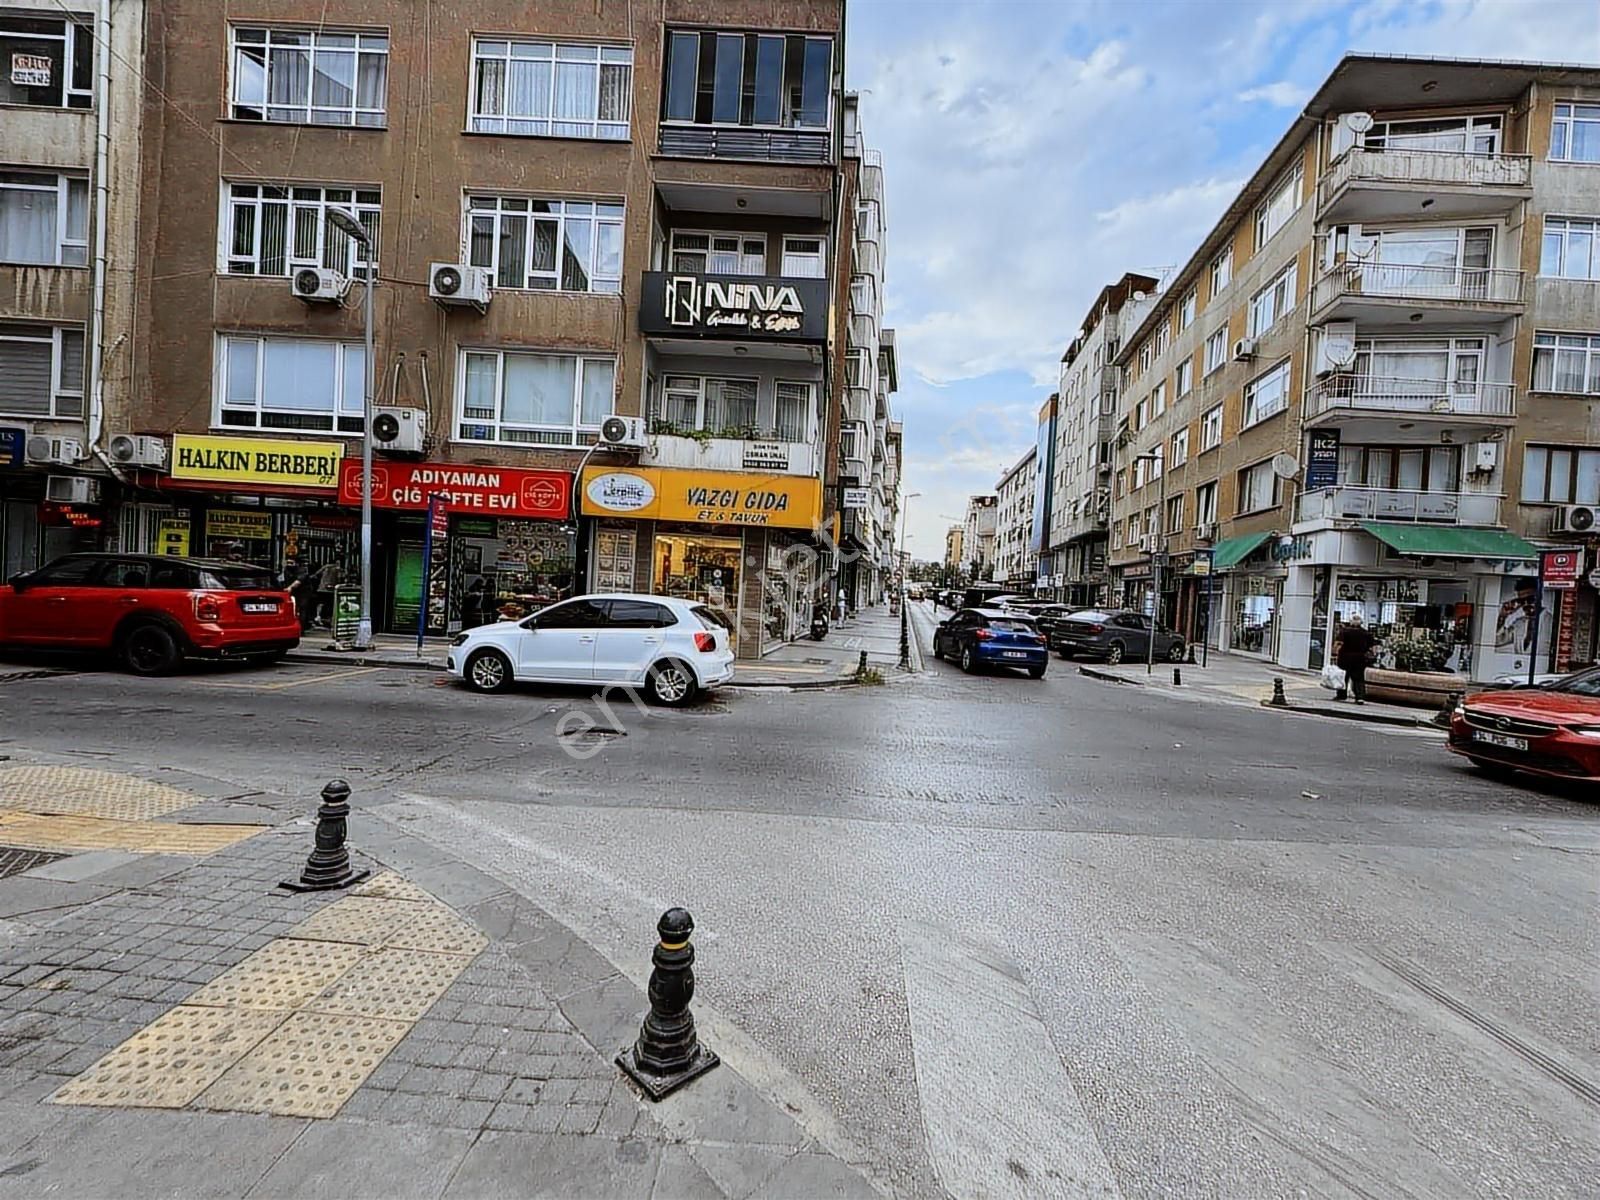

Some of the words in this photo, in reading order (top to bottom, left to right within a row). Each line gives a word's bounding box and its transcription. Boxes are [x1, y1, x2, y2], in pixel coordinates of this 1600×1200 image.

[178, 448, 251, 472] HALKIN
[254, 451, 337, 477] BERBERİ
[410, 470, 501, 488] ADIYAMAN
[392, 486, 422, 506] ÇİĞ
[488, 492, 517, 510] EVİ
[688, 487, 740, 509] YAZGI
[744, 491, 788, 511] GIDA
[697, 510, 714, 521] ET
[730, 512, 769, 524] TAVUK
